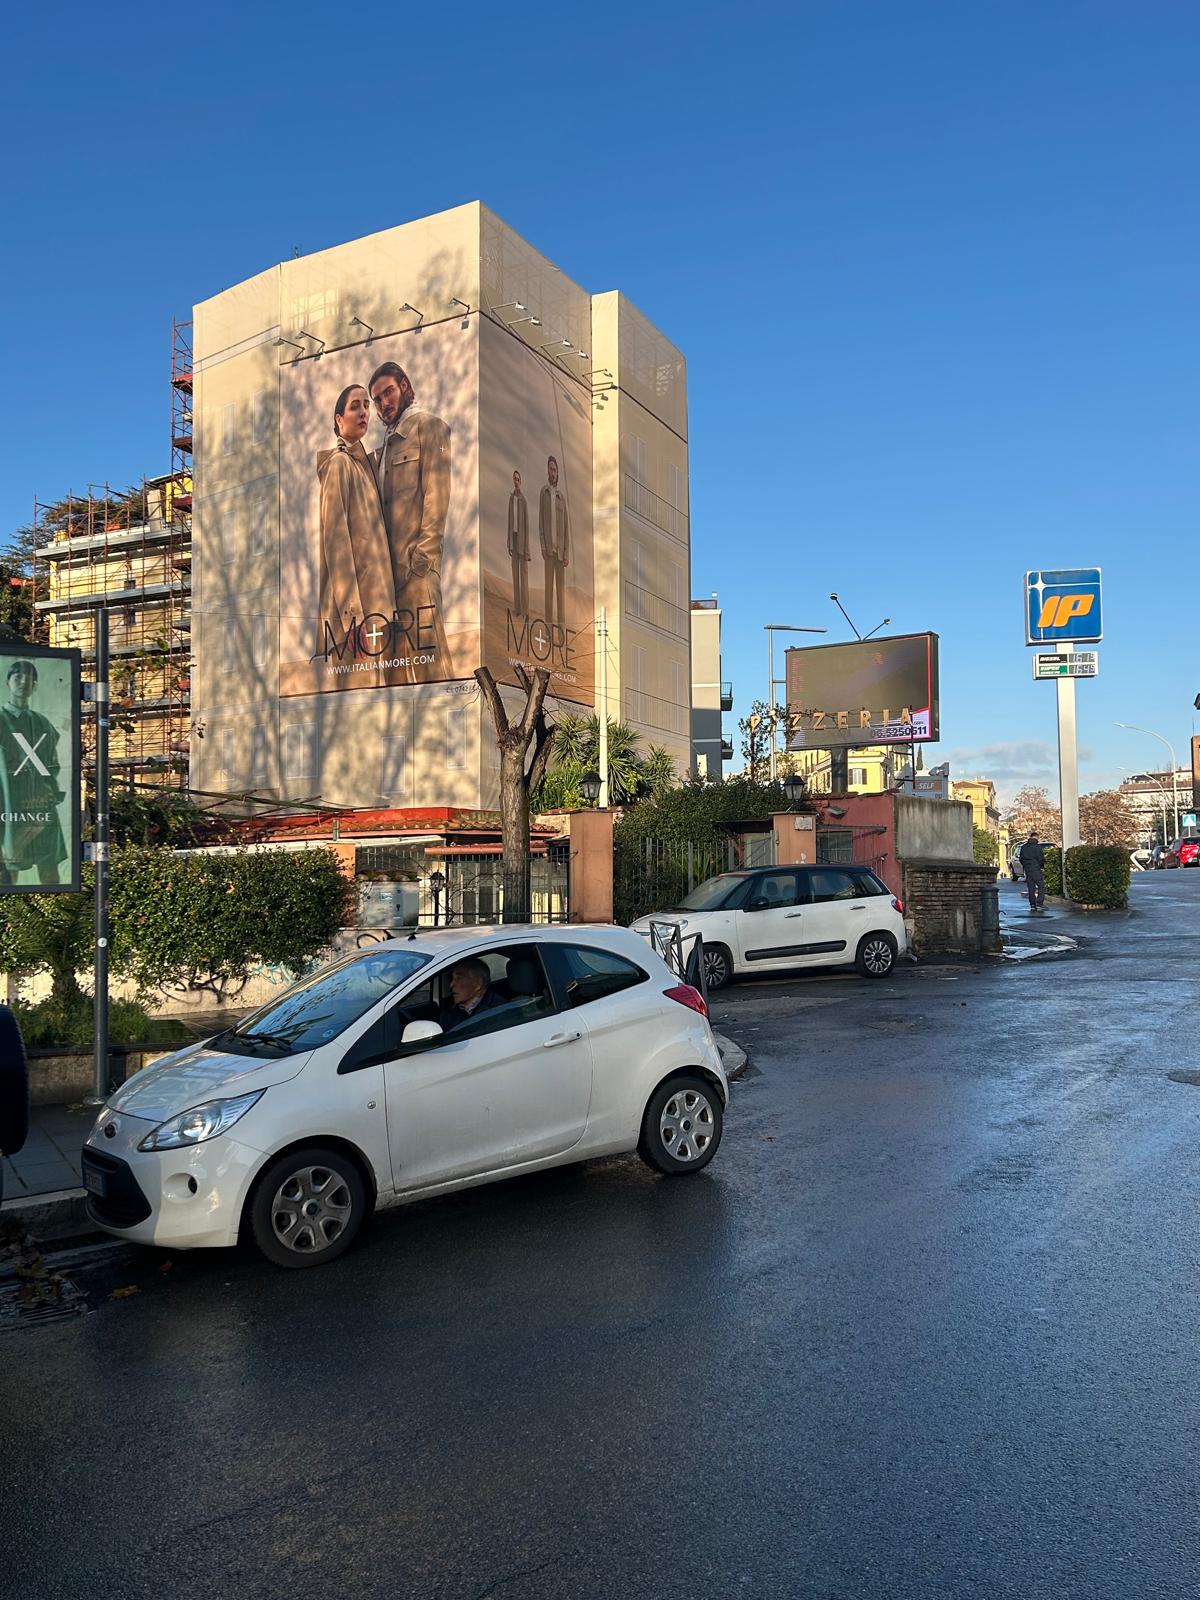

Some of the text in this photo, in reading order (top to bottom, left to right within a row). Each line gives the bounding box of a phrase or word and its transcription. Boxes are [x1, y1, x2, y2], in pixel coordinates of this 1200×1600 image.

[1037, 594, 1095, 628] IP
[324, 604, 437, 663] MORE
[506, 607, 577, 672] MORE
[326, 654, 436, 676] WWW.ITALIANMORE.COM
[918, 782, 936, 790] SELF
